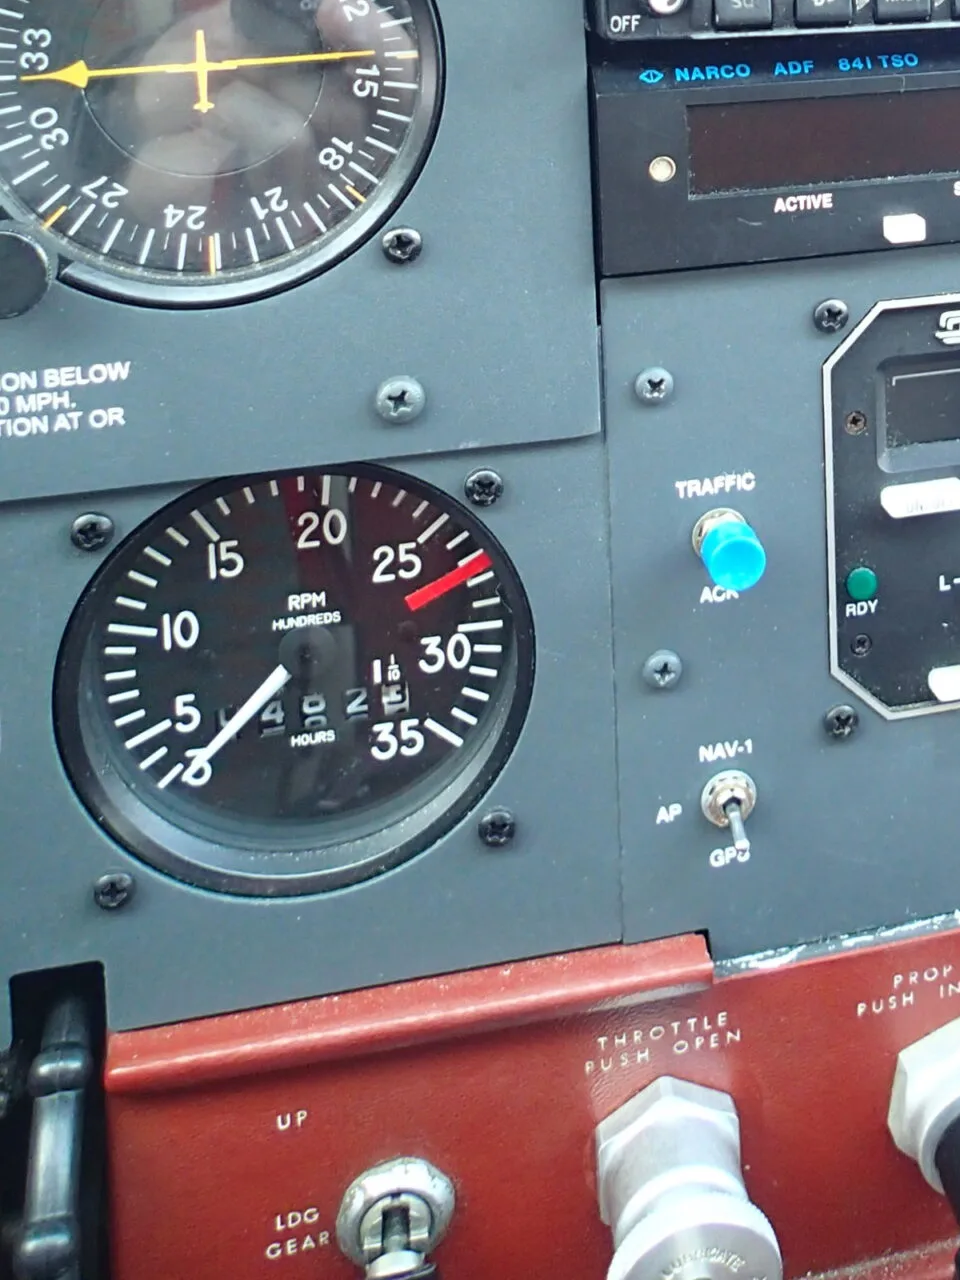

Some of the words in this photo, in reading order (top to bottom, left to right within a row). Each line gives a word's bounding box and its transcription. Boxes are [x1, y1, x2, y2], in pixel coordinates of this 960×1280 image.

[610, 15, 642, 32] OFF
[20, 28, 52, 72] 33
[353, 64, 380, 98] 15
[675, 63, 751, 82] NARCO
[774, 60, 814, 76] ADF
[877, 53, 919, 69] TSO
[30, 107, 69, 150] 30
[318, 135, 355, 172] 18
[80, 175, 129, 209] 27
[250, 186, 289, 220] 21
[774, 192, 833, 214] ACTIVE
[163, 203, 206, 231] 24
[44, 360, 131, 388] BELOW
[15, 390, 77, 413] MPH.
[53, 411, 83, 432] AT
[88, 406, 126, 429] OR
[675, 471, 756, 499] TRAFFIC
[297, 508, 347, 549] 20
[207, 539, 245, 580] 15
[372, 541, 423, 583] 25
[288, 591, 326, 612] RPM
[845, 600, 878, 618] RDY
[161, 609, 200, 651] 10
[272, 610, 342, 631] HUNDREDS
[418, 633, 471, 675] 30
[173, 693, 202, 733] 5
[290, 730, 336, 748] HOURS
[371, 718, 424, 760] 35
[699, 739, 753, 763] NAV-1
[656, 803, 683, 825] AP
[893, 963, 954, 991] PROP
[856, 990, 915, 1018] PUSH
[598, 1010, 729, 1052] THROTTLE
[584, 1047, 651, 1075] PUSH
[673, 1028, 742, 1056] OPEN
[276, 1109, 309, 1131] UP
[275, 1207, 320, 1232] LDG
[265, 1230, 330, 1261] GEAR
